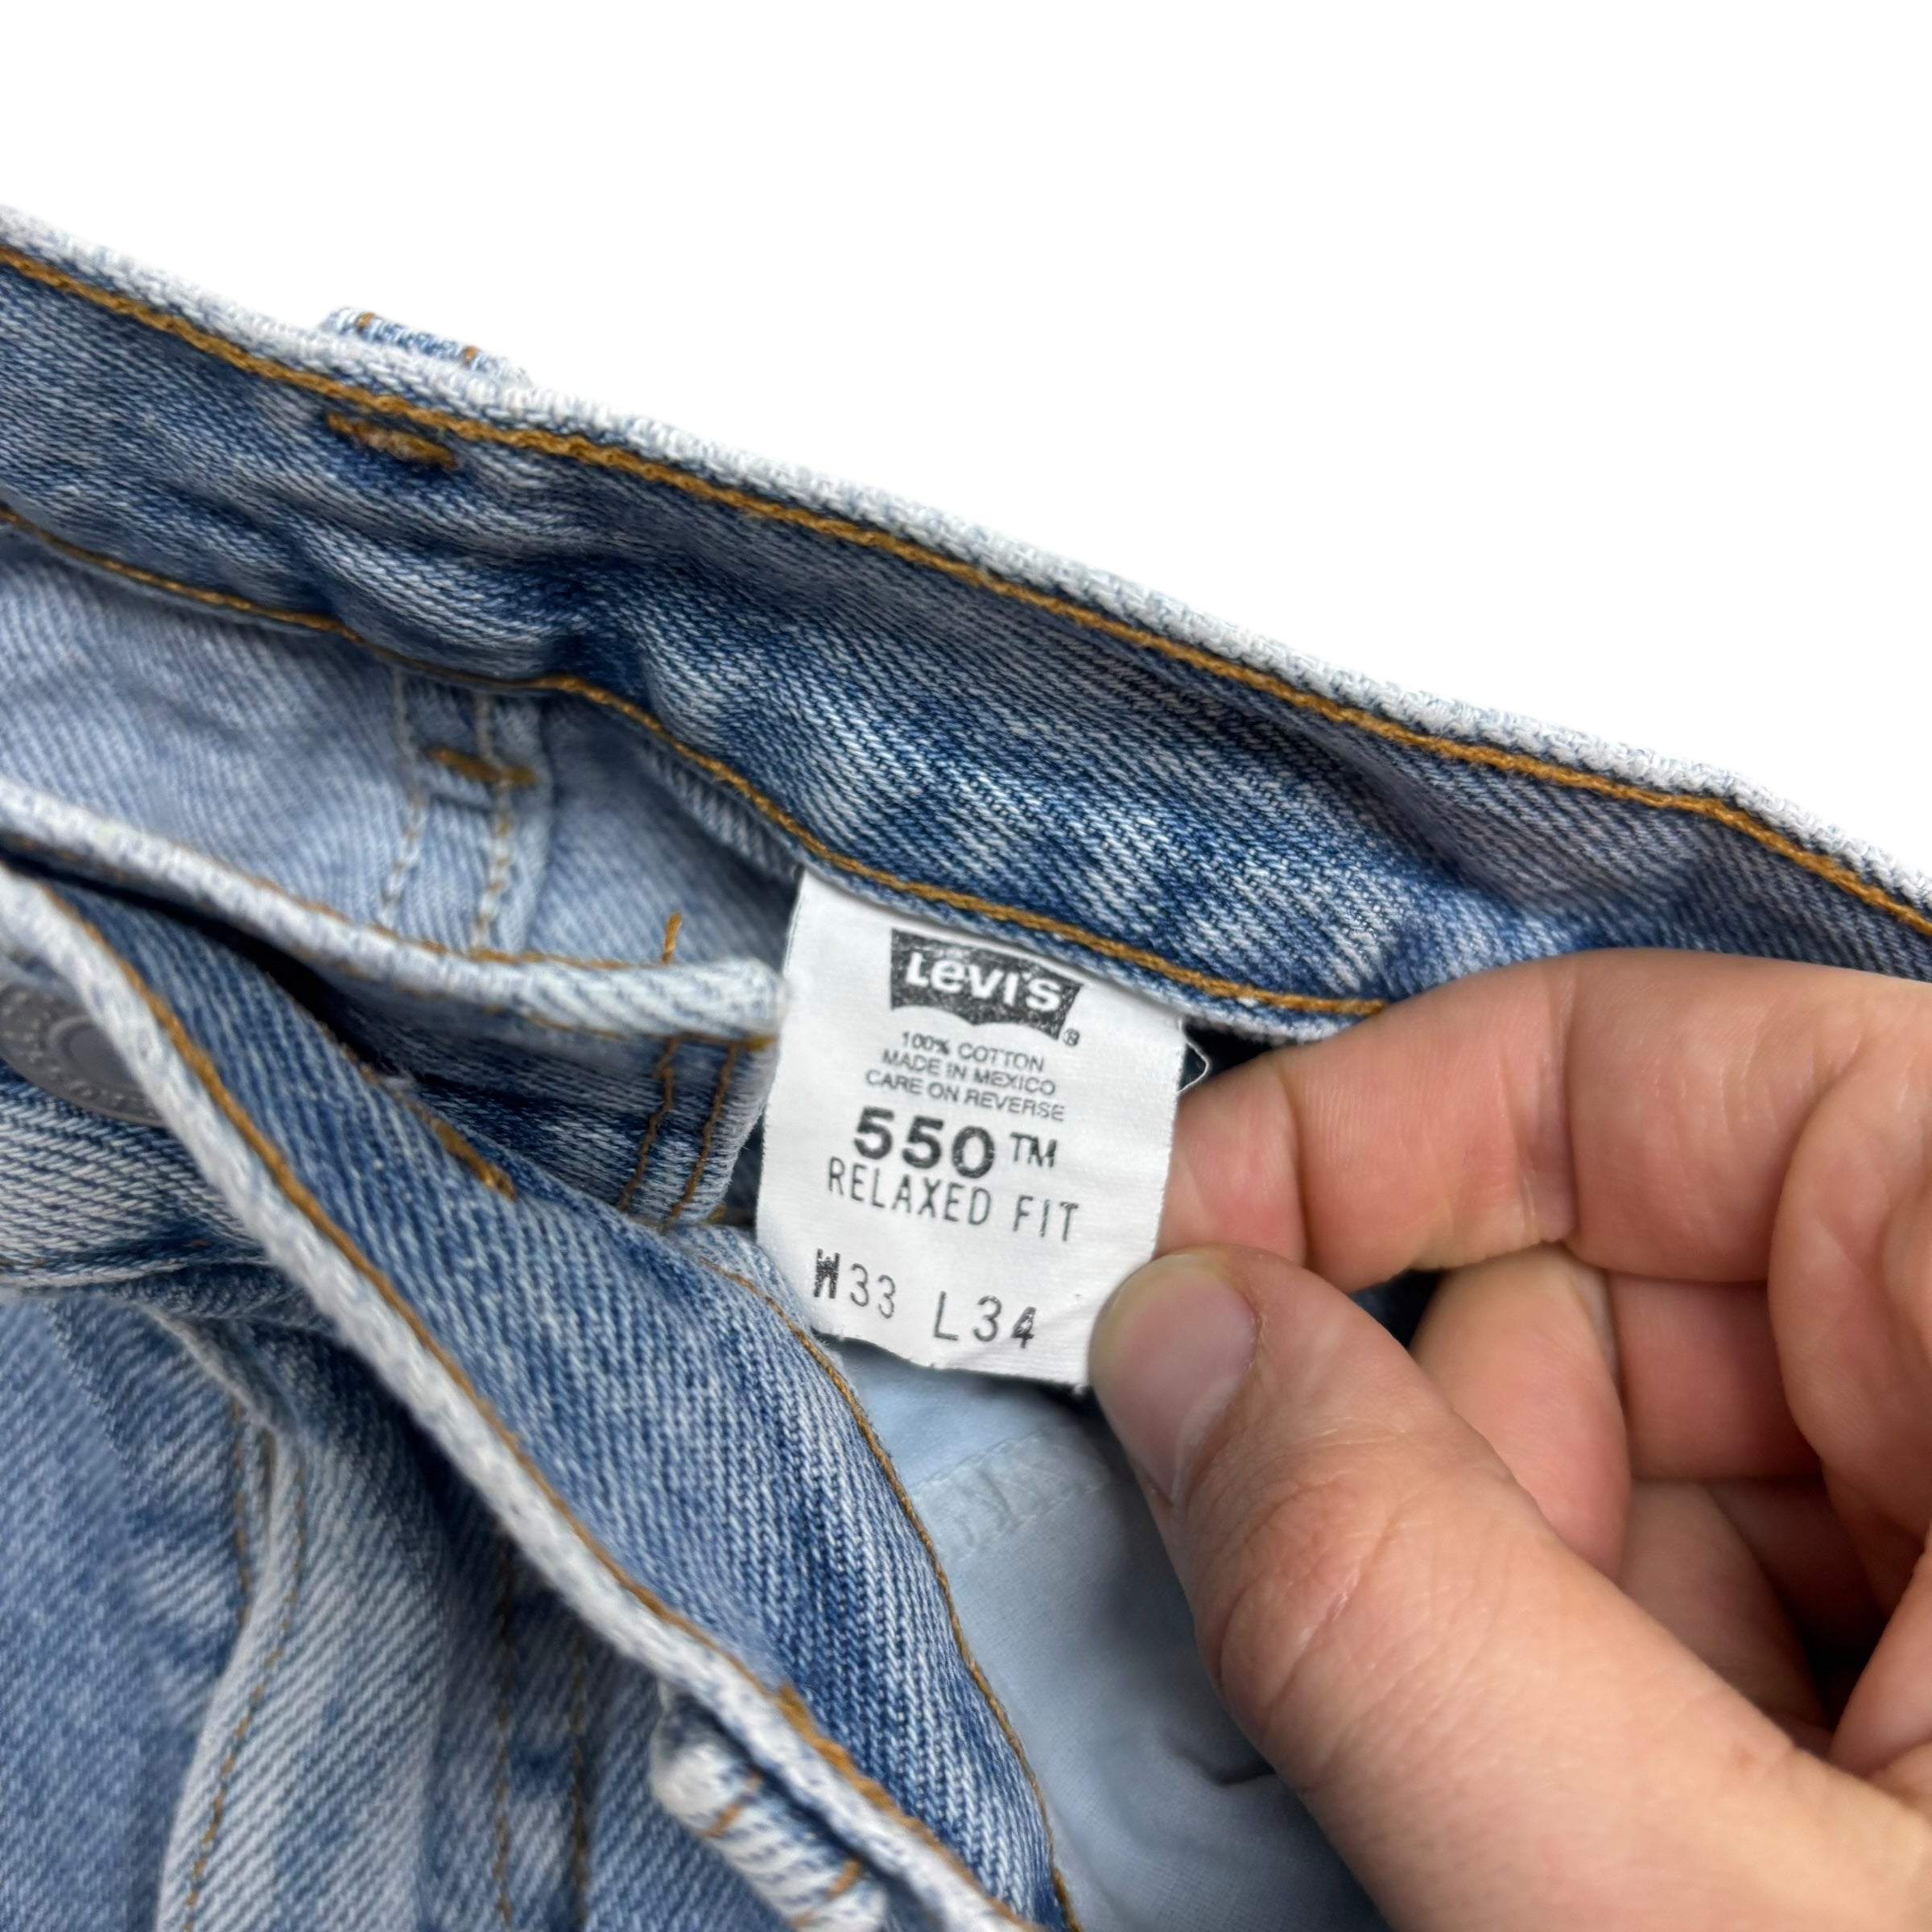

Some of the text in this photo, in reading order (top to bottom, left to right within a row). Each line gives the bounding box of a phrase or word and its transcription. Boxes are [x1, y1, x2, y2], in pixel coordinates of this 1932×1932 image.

[882, 1049, 1056, 1096] MADE IN MEXICO
[902, 1031, 1045, 1072] 100% COTTON
[865, 1069, 1065, 1122] CARE ON REVERSE
[828, 1156, 1080, 1242] RELAXED FIT
[813, 1248, 1038, 1349] W33 L34
